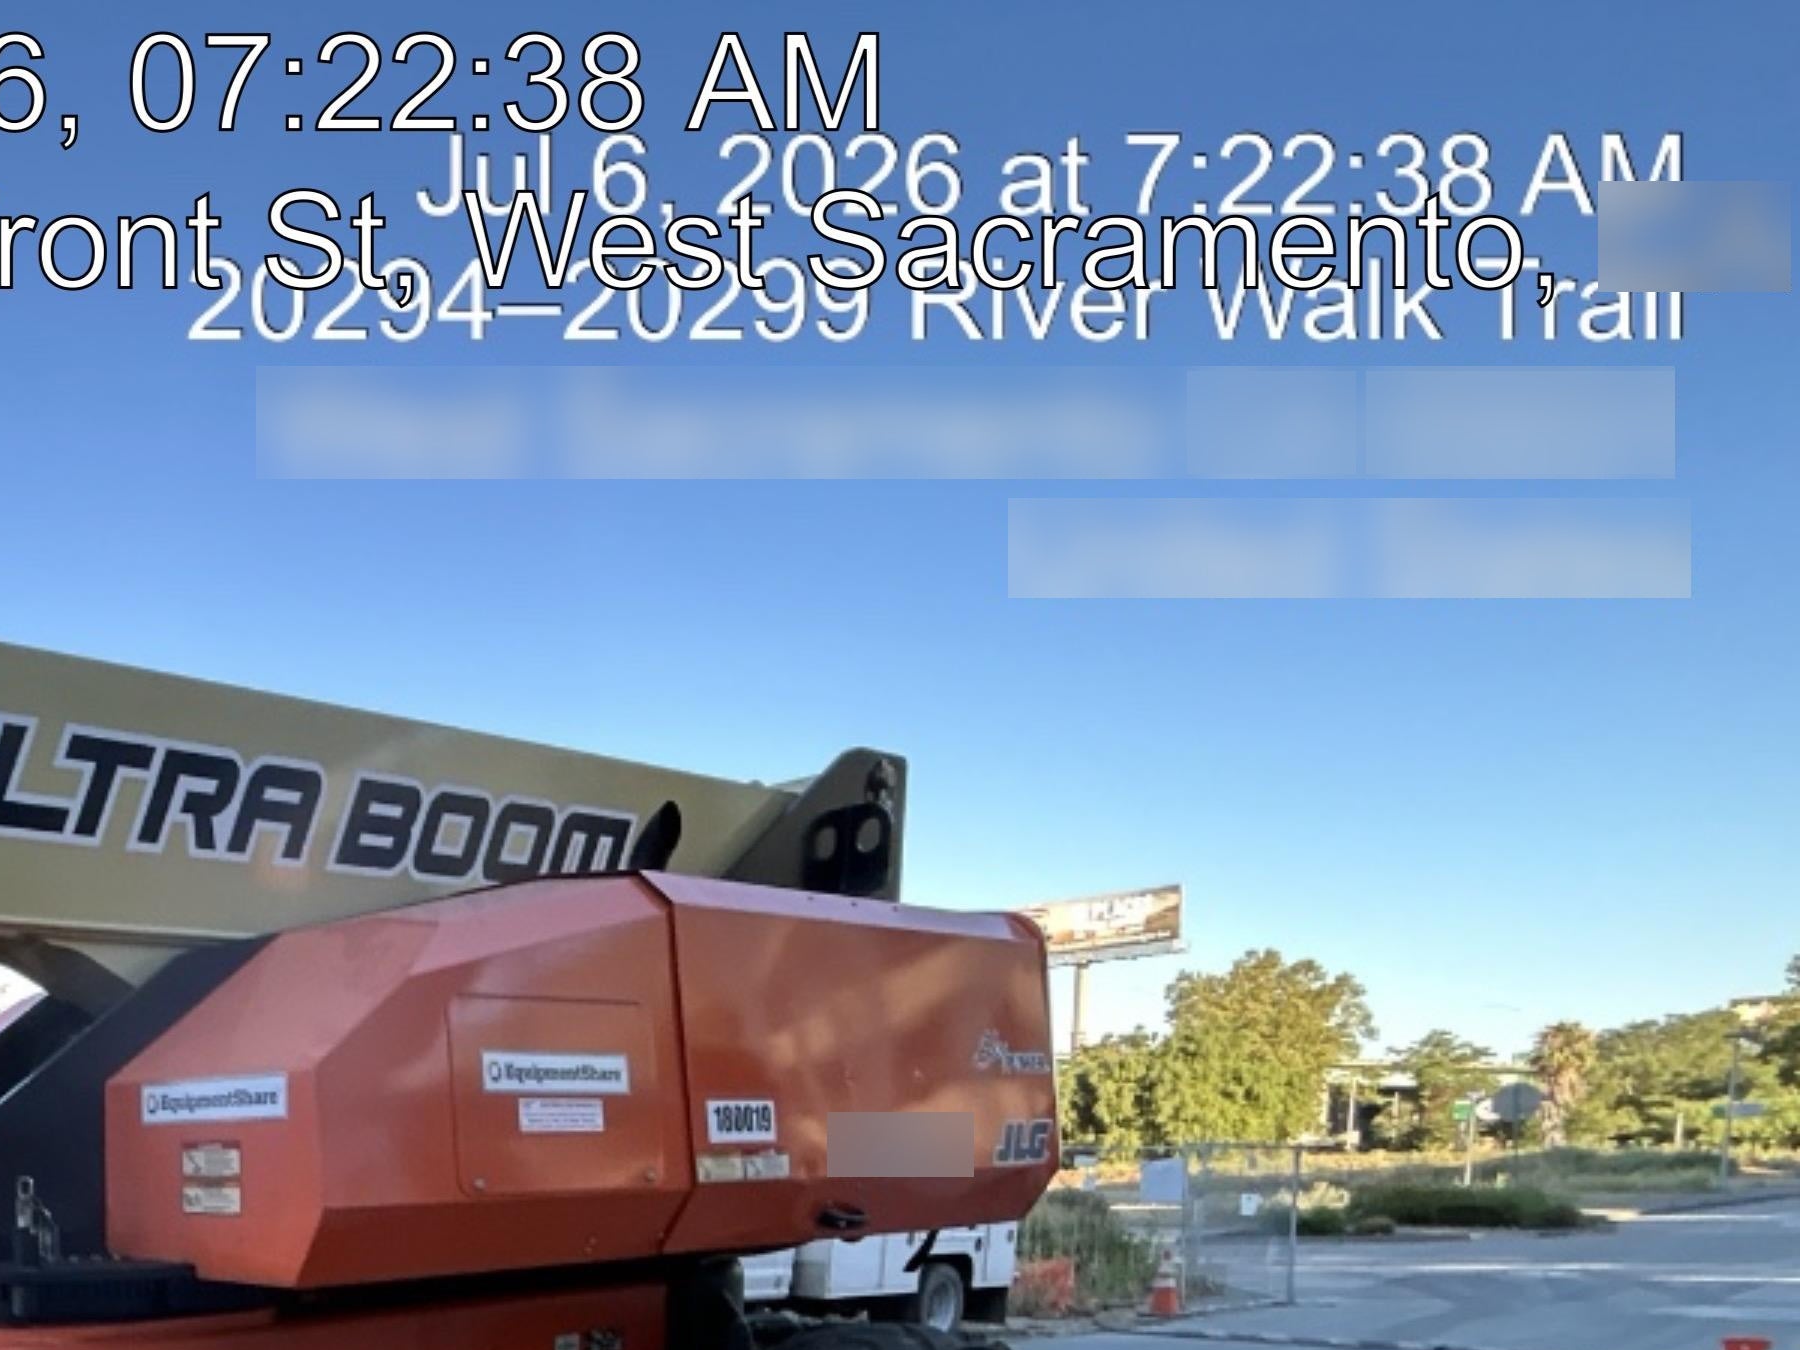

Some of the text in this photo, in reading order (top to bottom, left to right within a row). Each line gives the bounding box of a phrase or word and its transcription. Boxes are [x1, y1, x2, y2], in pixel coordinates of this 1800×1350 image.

[326, 768, 638, 884] BOOM
[502, 1061, 622, 1085] EquipmentShare
[159, 1087, 278, 1115] EquipmentShare
[993, 1118, 1054, 1169] JLG
